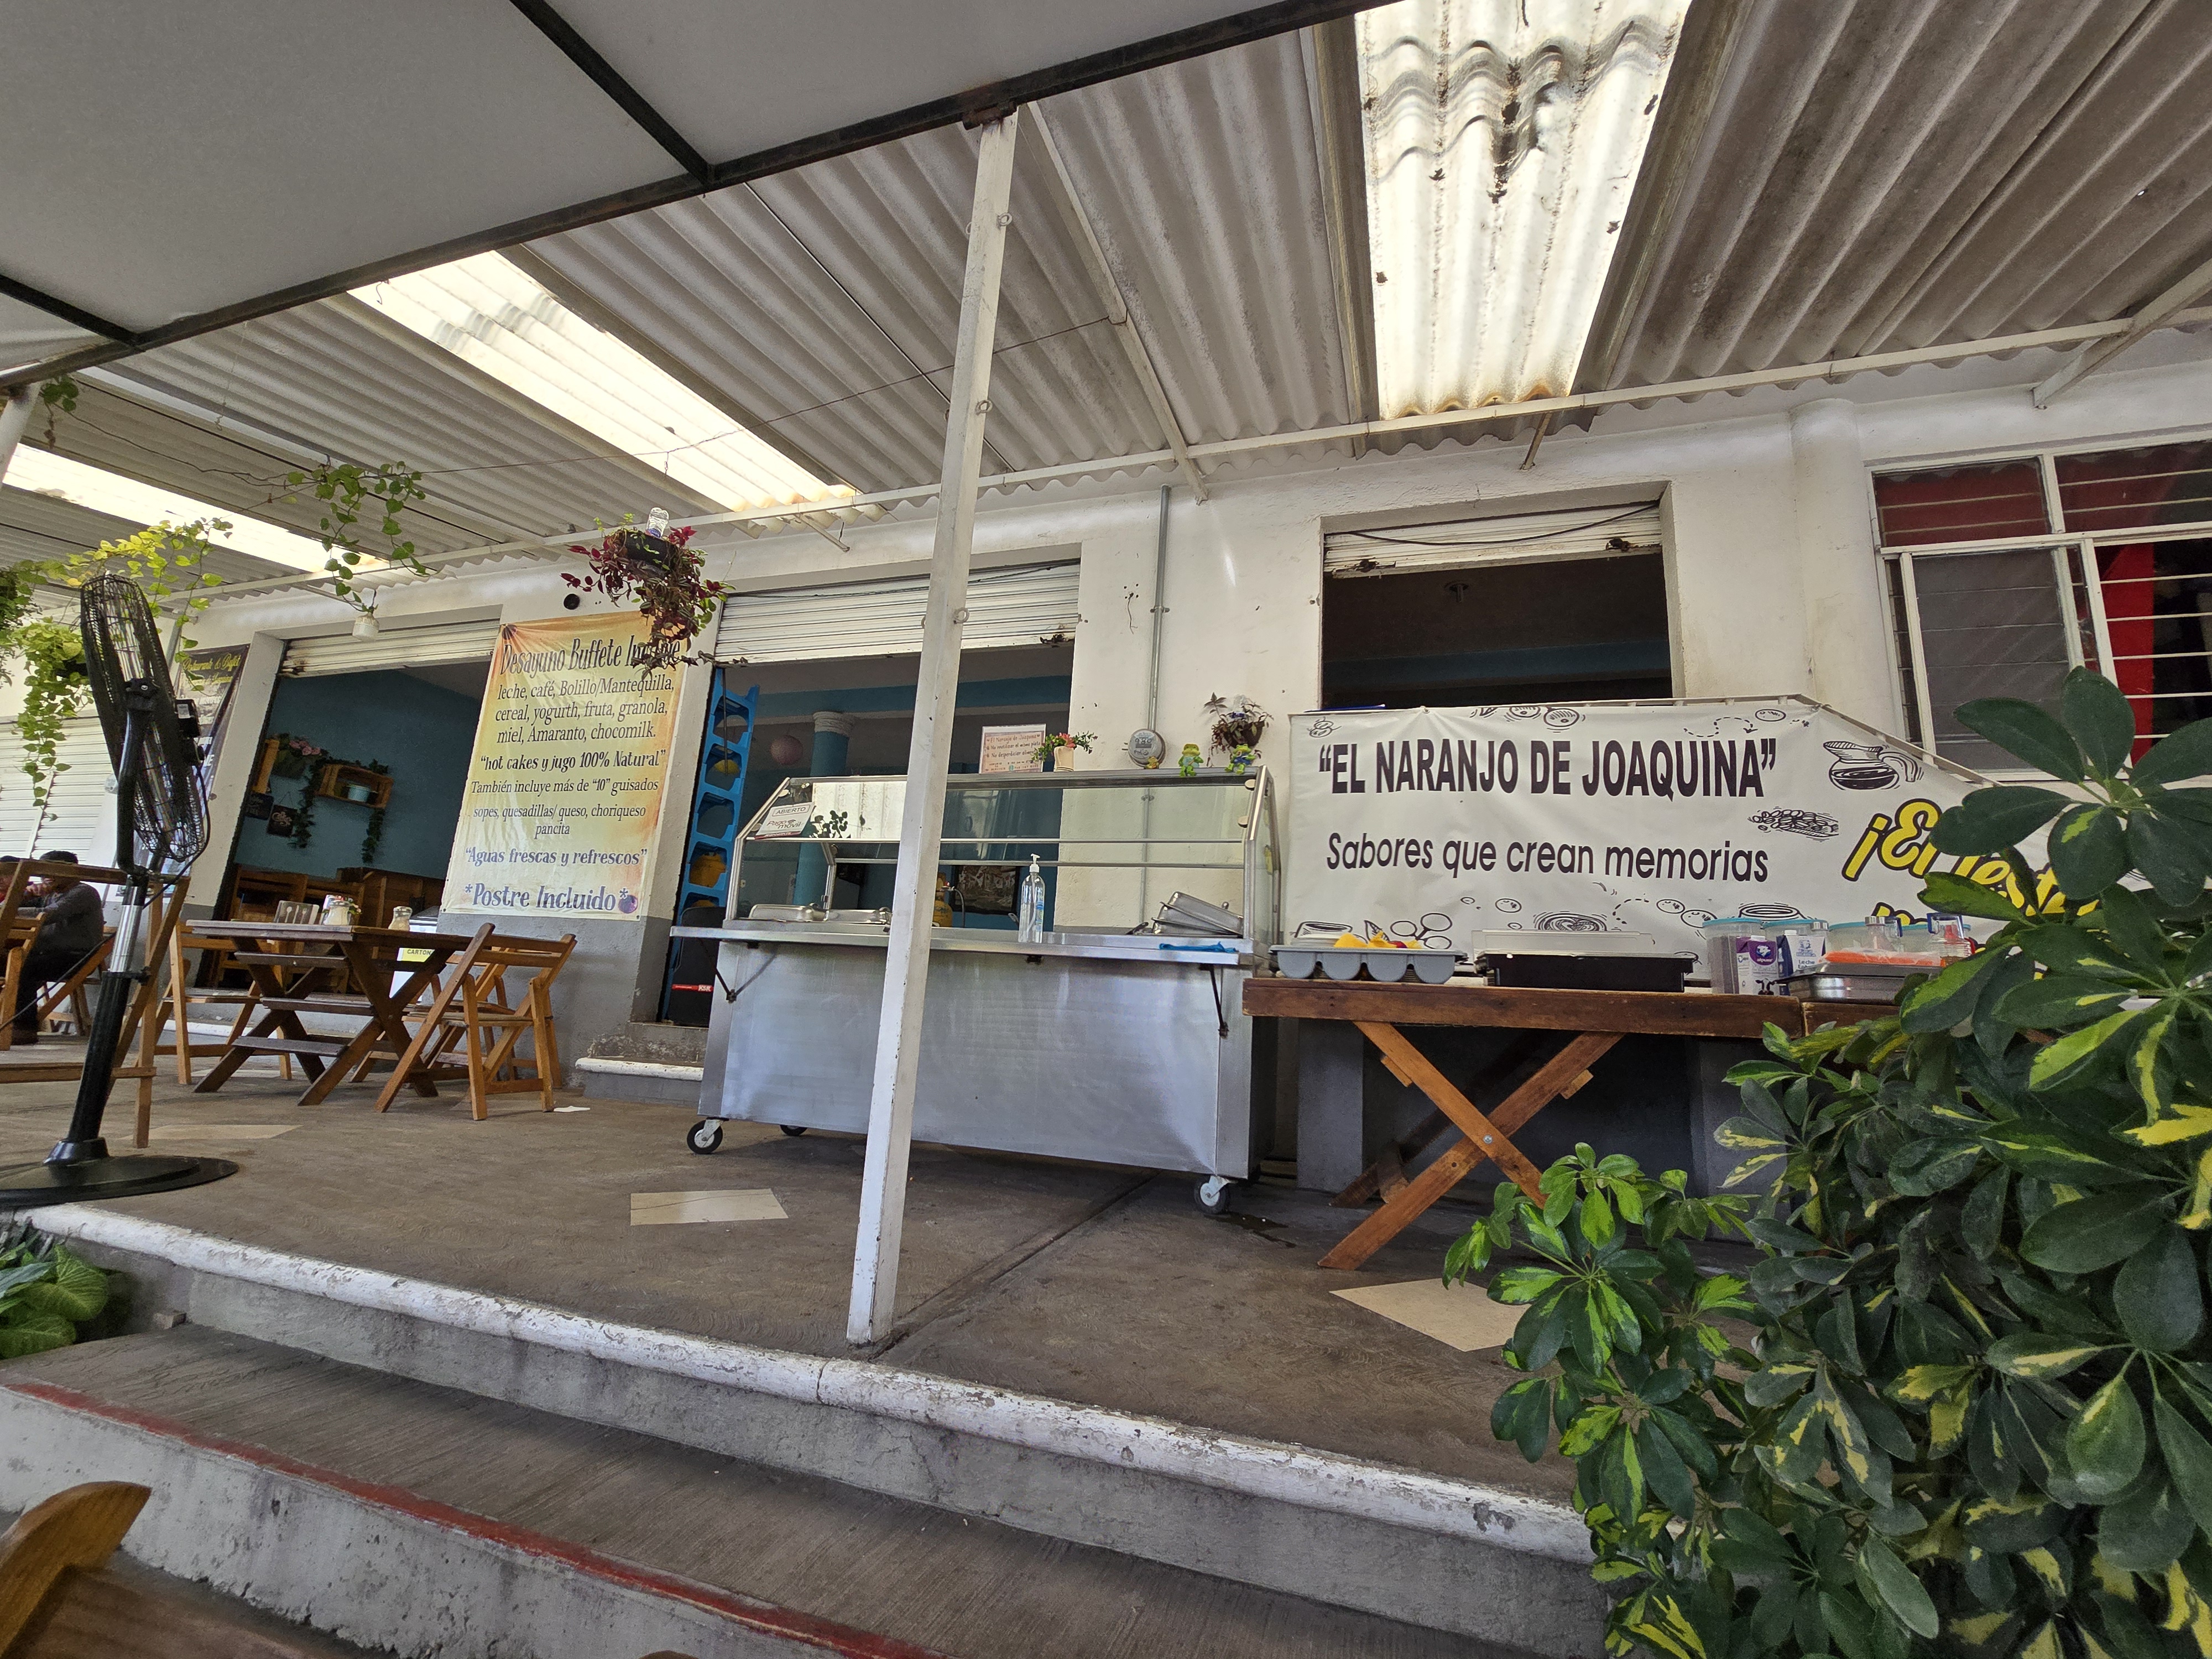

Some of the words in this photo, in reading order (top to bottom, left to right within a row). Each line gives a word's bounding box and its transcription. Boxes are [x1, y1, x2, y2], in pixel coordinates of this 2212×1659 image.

[500, 644, 566, 678] Desayuno
[568, 638, 622, 670] Buffete
[498, 684, 528, 700] leche,
[531, 680, 556, 698] café,
[495, 705, 530, 722] cereal,
[531, 701, 580, 726] yogurth,
[583, 701, 615, 718] fruta,
[617, 697, 668, 722] granola,
[497, 726, 524, 745] miel,
[526, 726, 587, 743] Amaranto,
[591, 721, 656, 739] chocomilk.
[481, 755, 503, 770] “hot
[507, 754, 539, 770] cakes
[541, 759, 550, 772] y
[550, 754, 575, 773] jugo
[579, 751, 609, 769] 100%
[613, 749, 666, 768] Natural”
[1319, 743, 1365, 794] “EL
[1376, 738, 1519, 794] NARANJO
[1531, 740, 1571, 795] DE
[1582, 738, 1776, 802] JOAQUINA”
[471, 780, 512, 794] También
[514, 780, 551, 797] incluye
[554, 779, 574, 792] más
[577, 779, 589, 792] de
[611, 778, 658, 796] guisados
[473, 806, 499, 822] sopes,
[502, 804, 557, 822] quesadillas/
[558, 806, 588, 822] queso,
[591, 804, 646, 822] choriqueso
[534, 823, 570, 839] pancita
[466, 847, 505, 867] “Aguas
[509, 848, 557, 864] frescas
[561, 852, 569, 867] y
[572, 848, 648, 865] refrescos”
[1327, 832, 1433, 869] Sabores
[1443, 840, 1496, 878] que
[1506, 841, 1594, 874] crean
[1605, 841, 1768, 882] memorias
